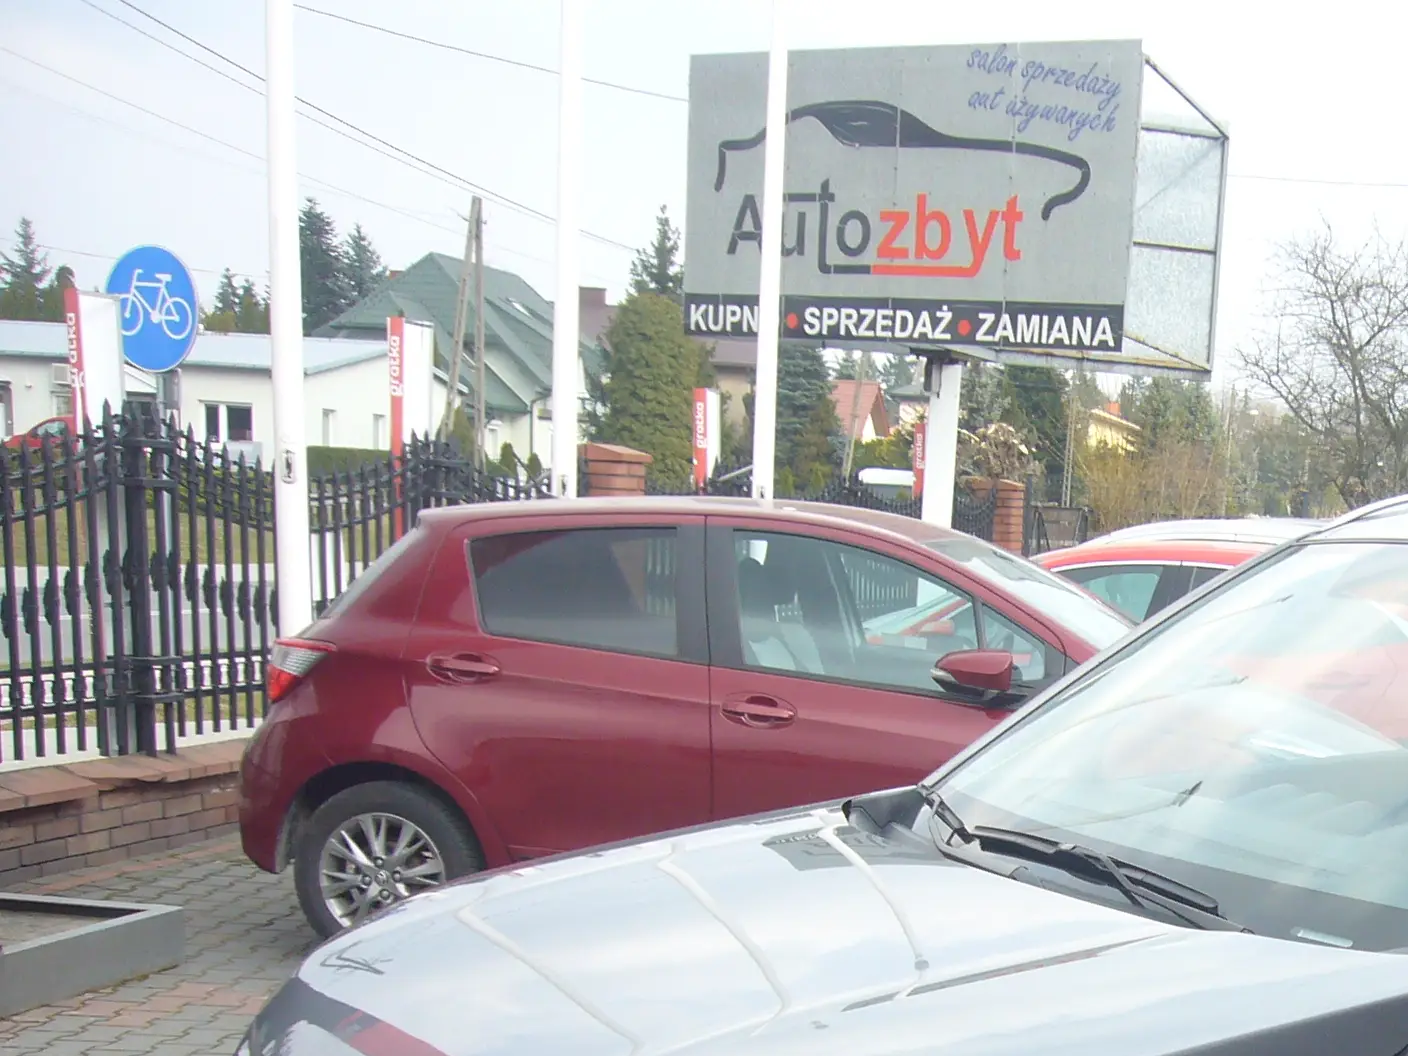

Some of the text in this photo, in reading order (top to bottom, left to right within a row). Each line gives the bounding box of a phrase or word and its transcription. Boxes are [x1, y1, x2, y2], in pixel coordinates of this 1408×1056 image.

[966, 43, 1122, 112] salon sprzedaży
[967, 87, 1120, 142] aut używanych
[727, 178, 1024, 278] Autozbyt
[689, 303, 1116, 347] KUPN SPRZEDAŻ ZAMIANA
[389, 335, 404, 397] gratka
[695, 402, 707, 449] gratka
